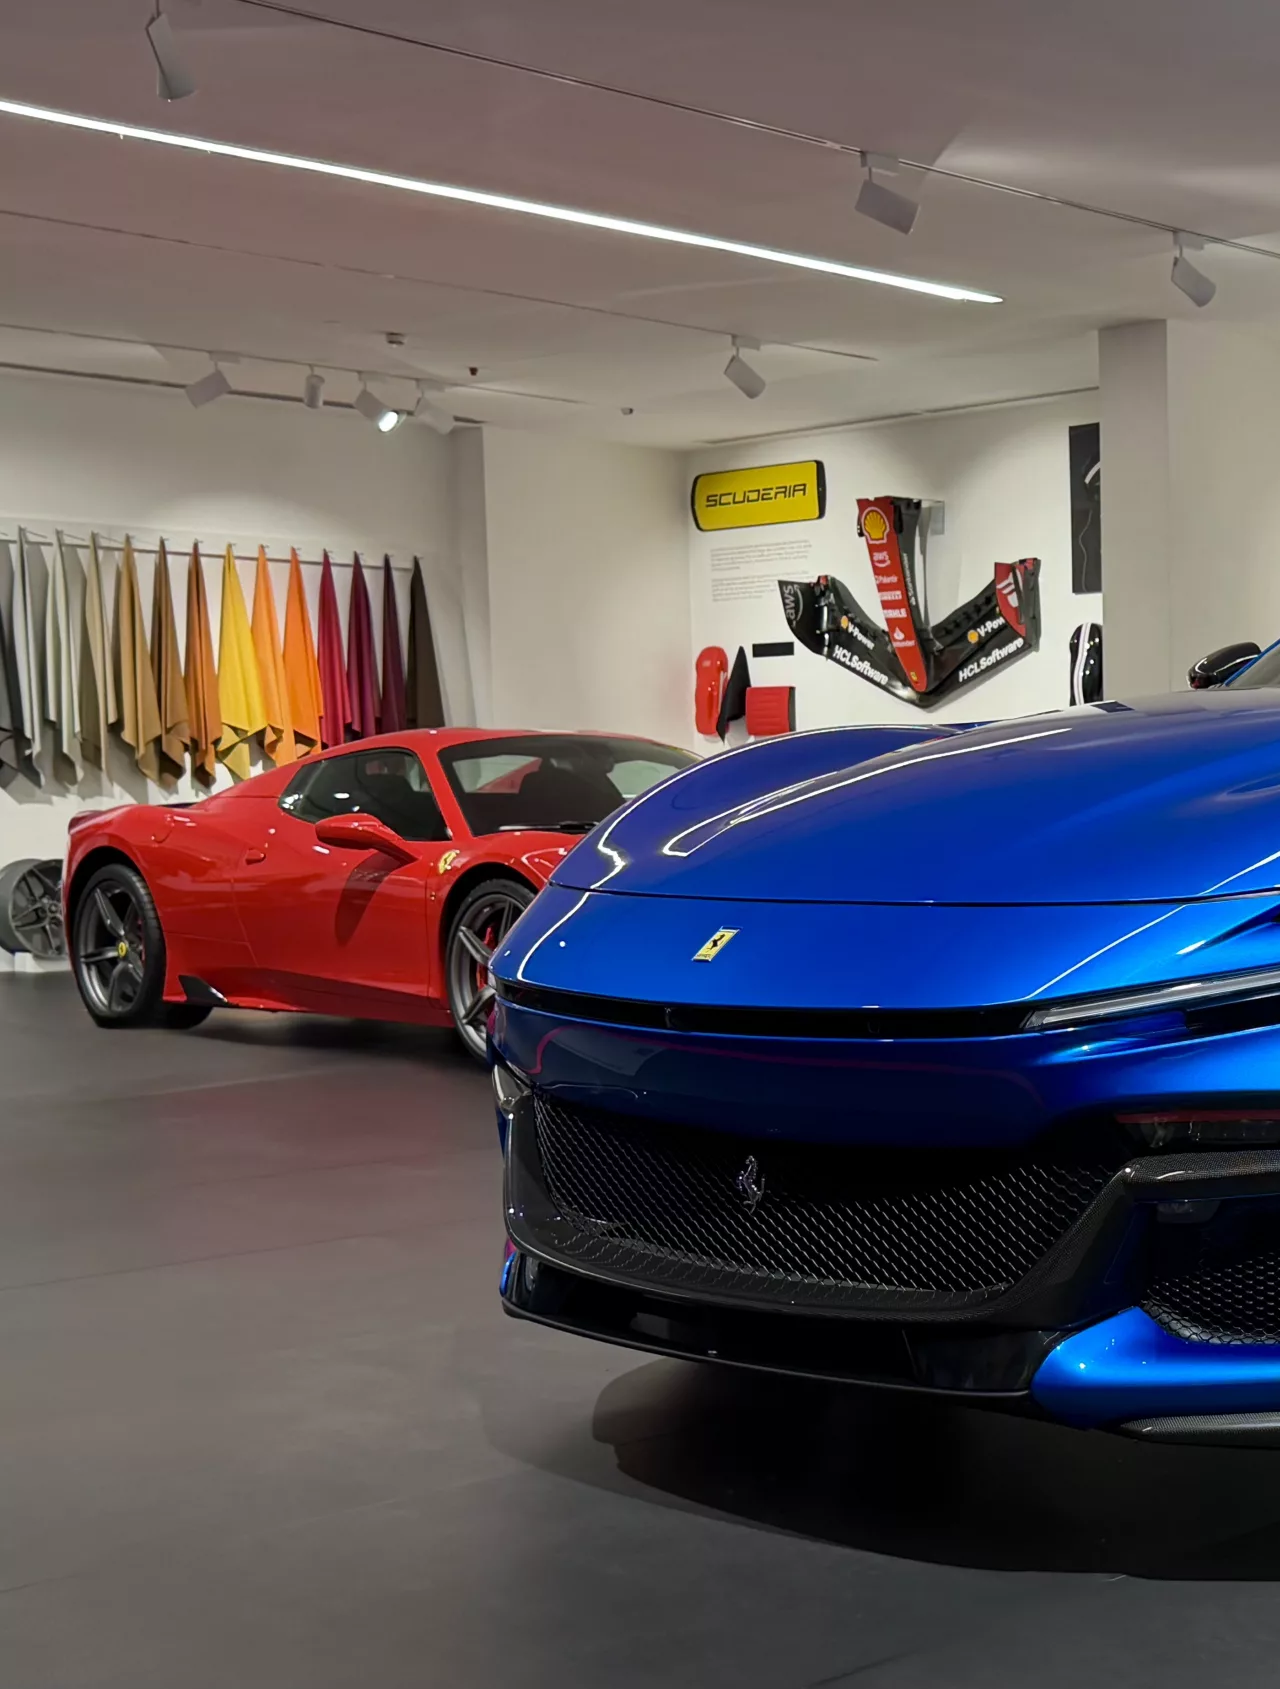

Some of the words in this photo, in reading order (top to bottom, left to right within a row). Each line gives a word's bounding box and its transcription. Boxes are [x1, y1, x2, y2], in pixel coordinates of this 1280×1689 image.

[705, 483, 807, 508] SCUDERIA
[848, 621, 875, 651] V-Power
[832, 644, 889, 685] HCLSoftware
[958, 637, 1024, 682] HCLSoftware
